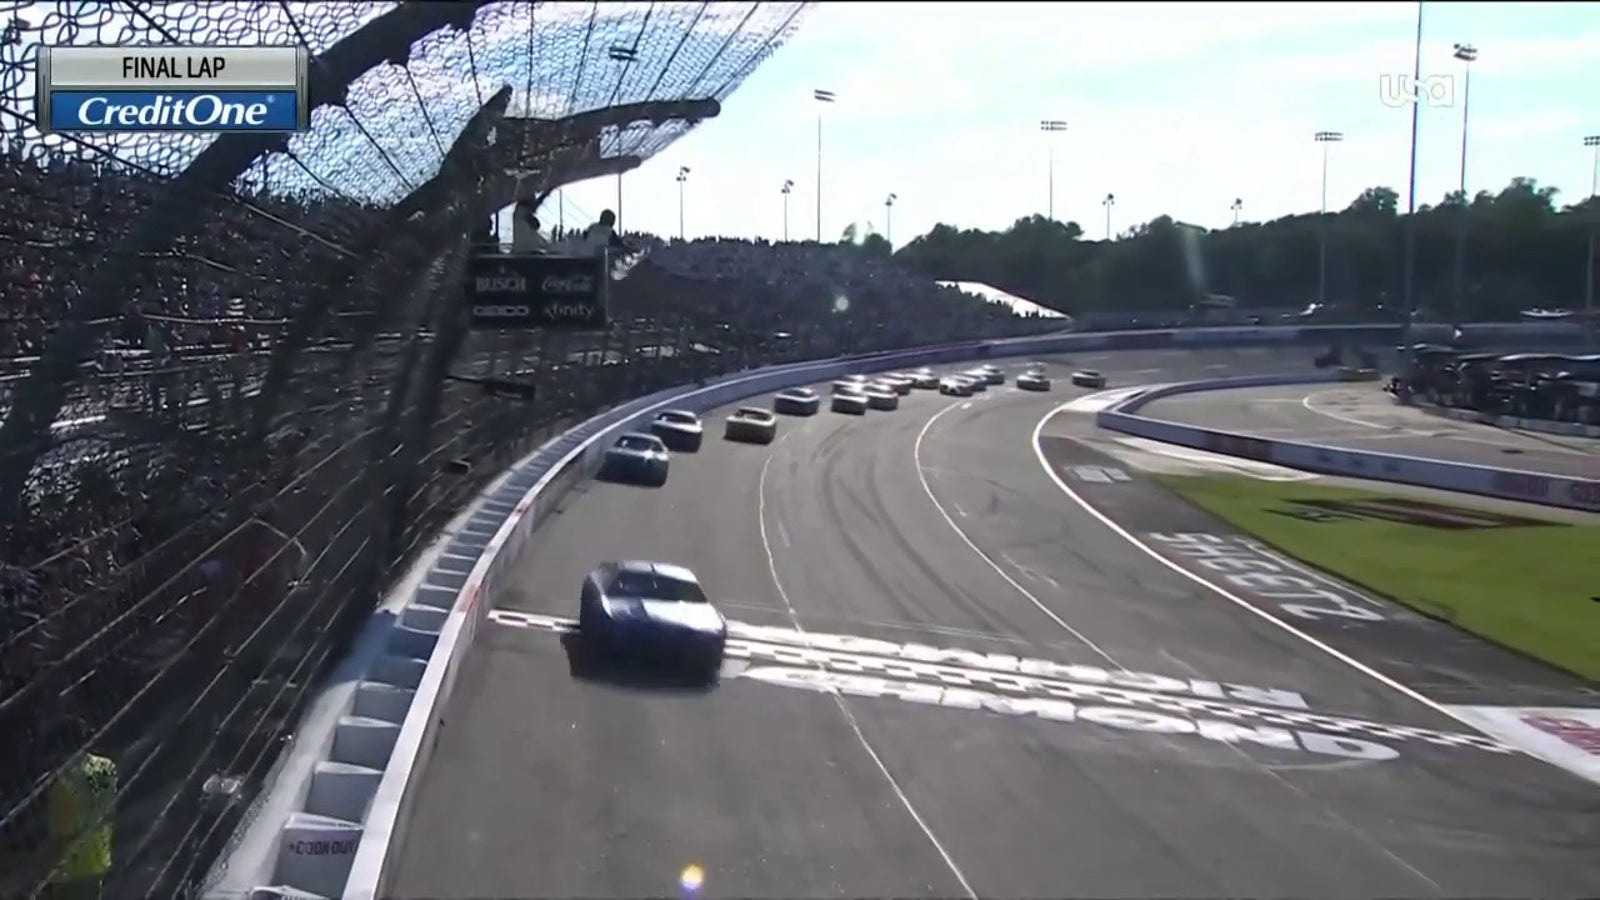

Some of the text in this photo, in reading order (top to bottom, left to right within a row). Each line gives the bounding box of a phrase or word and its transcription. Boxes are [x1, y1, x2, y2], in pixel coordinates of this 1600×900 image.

[476, 276, 526, 292] BUSCH
[473, 305, 529, 316] GEICO
[544, 302, 594, 319] xfinity
